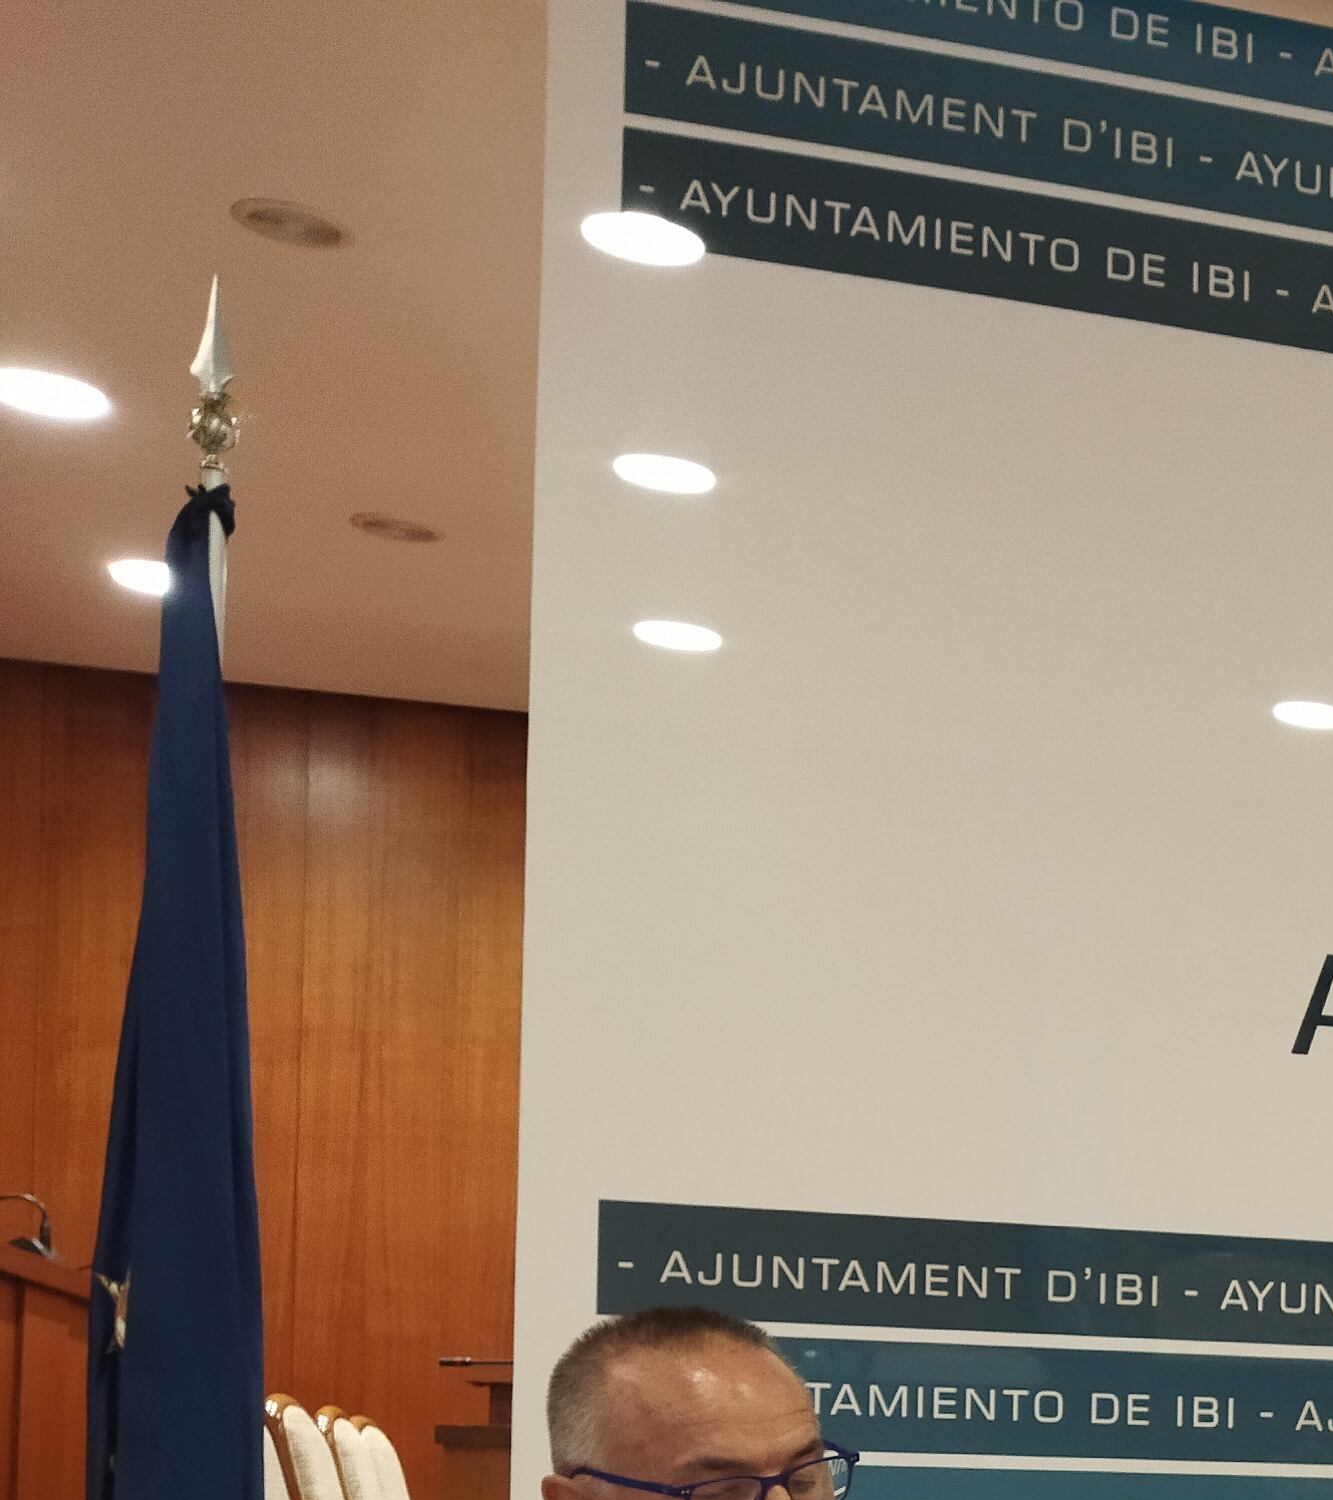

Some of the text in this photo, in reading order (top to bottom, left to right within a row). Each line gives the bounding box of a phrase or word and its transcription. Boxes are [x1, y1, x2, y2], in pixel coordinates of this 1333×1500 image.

[1110, 7, 1169, 48] DE
[1195, 23, 1253, 64] IBI
[686, 55, 1037, 142] AJUNTAMENT
[1063, 118, 1173, 168] D'IBI
[680, 179, 1080, 272] AYUNTAMIENTO
[1106, 246, 1165, 288] DE
[1192, 261, 1250, 302] IBI
[660, 1250, 1022, 1300] AJUNTAMENT
[1047, 1267, 1158, 1307] D'IBI
[1090, 1392, 1150, 1426] DE
[1176, 1395, 1234, 1429] IBI
